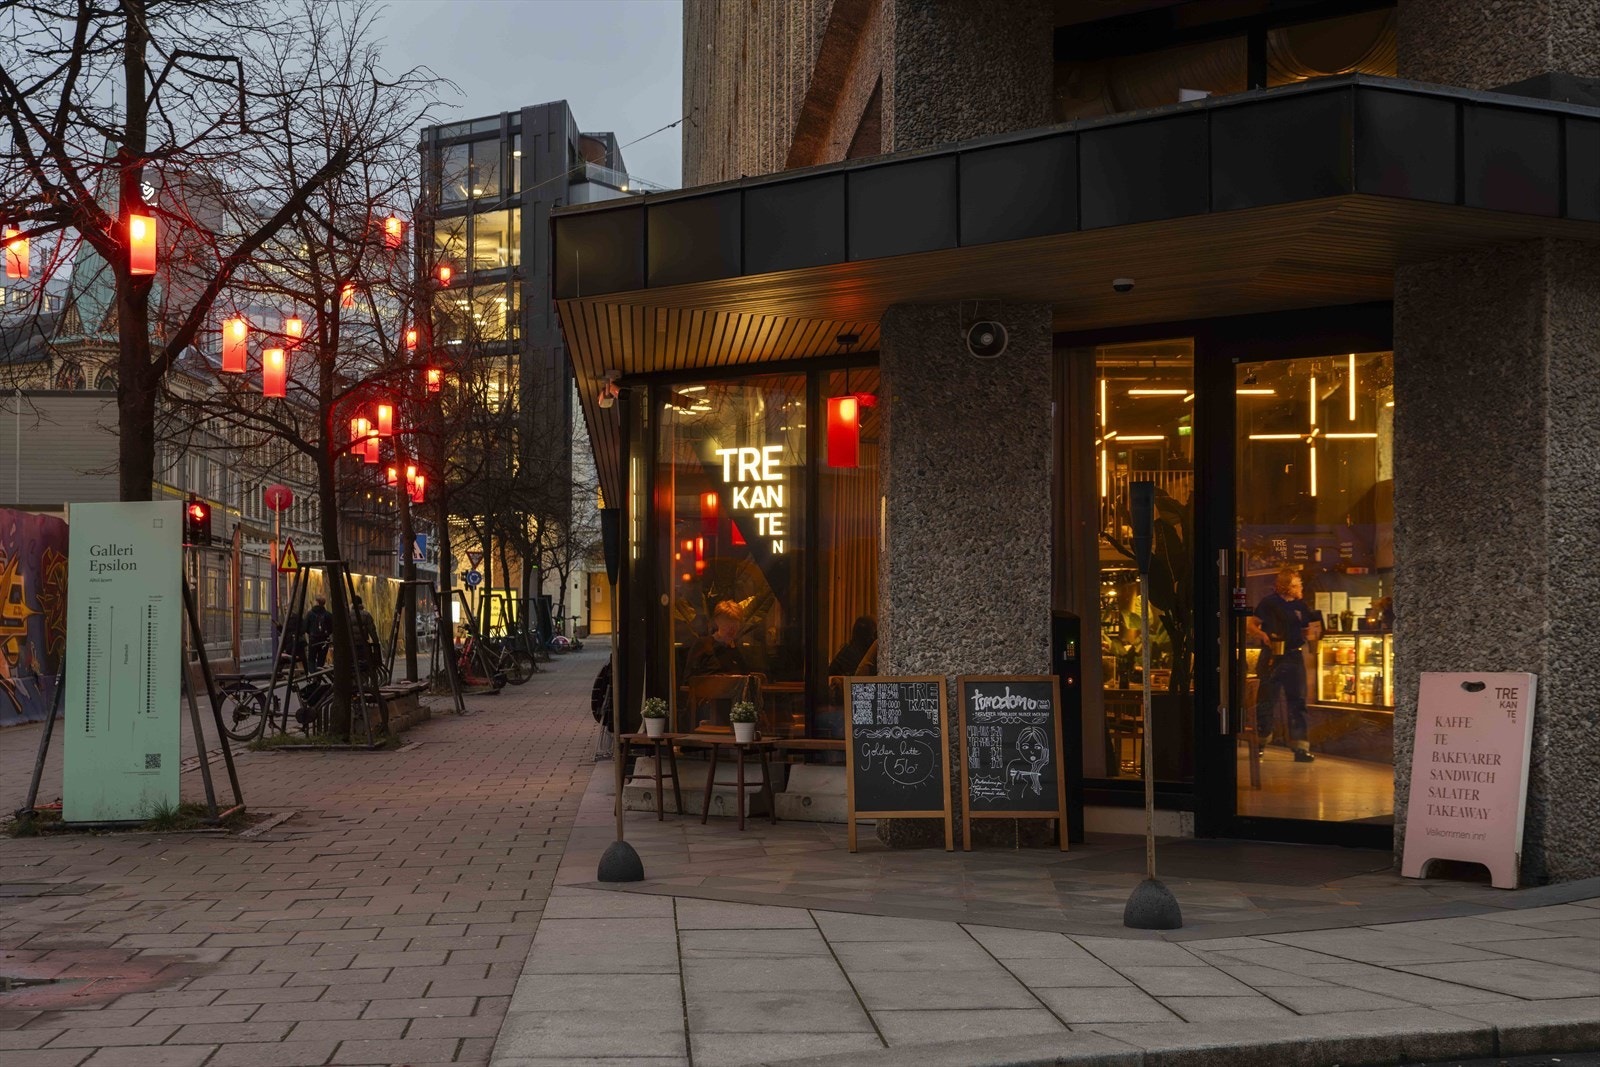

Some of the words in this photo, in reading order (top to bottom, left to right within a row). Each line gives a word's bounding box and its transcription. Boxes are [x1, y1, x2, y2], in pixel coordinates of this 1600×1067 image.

[716, 445, 783, 482] TRE
[733, 485, 783, 509] KAN
[754, 513, 783, 536] TE
[89, 543, 133, 557] Galleri
[772, 539, 784, 554] N
[1272, 539, 1287, 547] TRE
[89, 558, 137, 575] Epsilon
[900, 683, 938, 701] TRE
[1495, 687, 1519, 700] TRE
[909, 699, 938, 711] KAN
[1499, 700, 1518, 709] KAN
[1506, 709, 1517, 719] TE
[1435, 715, 1473, 729] KAFFE
[1433, 733, 1449, 746] TE
[861, 742, 895, 771] Golden
[900, 740, 921, 755] latte
[1431, 751, 1502, 766] BAKEVARER
[1430, 769, 1496, 784] SANDWICH
[1428, 786, 1480, 801] SALATER
[1427, 804, 1491, 820] TAKEAWAY
[1425, 826, 1470, 841] Velkommen
[1471, 832, 1487, 841] inn!
